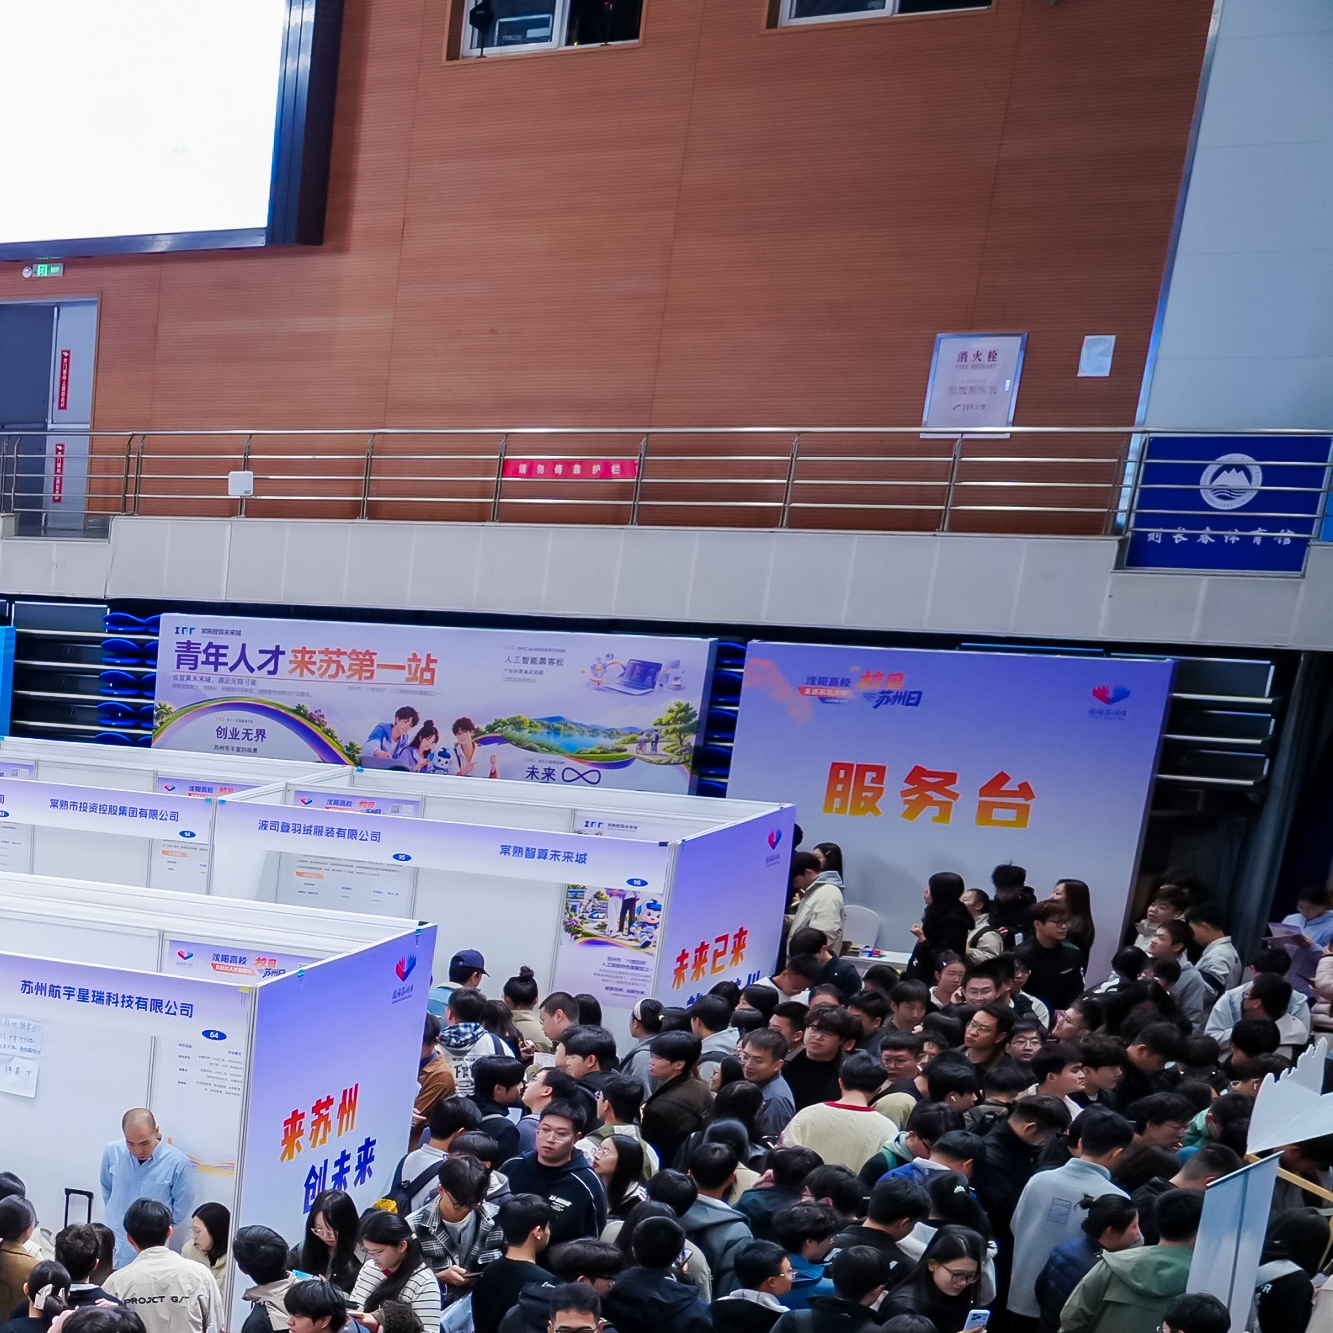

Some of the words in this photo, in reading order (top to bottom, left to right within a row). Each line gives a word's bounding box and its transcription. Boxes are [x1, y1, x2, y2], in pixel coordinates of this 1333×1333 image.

[957, 351, 998, 363] 消火栓
[518, 464, 620, 475] 请勿倚靠护栏
[174, 640, 286, 675] 青年人才
[288, 645, 439, 686] 来苏第一站
[504, 655, 565, 667] 人工智能黑客松
[805, 675, 850, 688] 沈阳高校
[872, 689, 923, 709] 苏州日
[216, 726, 267, 743] 创业无界
[525, 765, 556, 782] 未来
[822, 761, 1037, 829] 服务台
[49, 797, 179, 822] 常熟市投资控股集团有限公司
[257, 819, 382, 844] 波司登羽绒服装有限公司
[499, 844, 588, 865] 常熟智算未来城
[212, 952, 247, 966] 沈阳高校
[254, 956, 277, 968] 校园
[672, 926, 748, 990] 未来已来
[20, 980, 195, 1019] 苏州航宇星瑞科技有限公司
[209, 1031, 219, 1039] 64
[279, 1083, 361, 1163] 来苏州
[303, 1137, 377, 1215] 创未来
